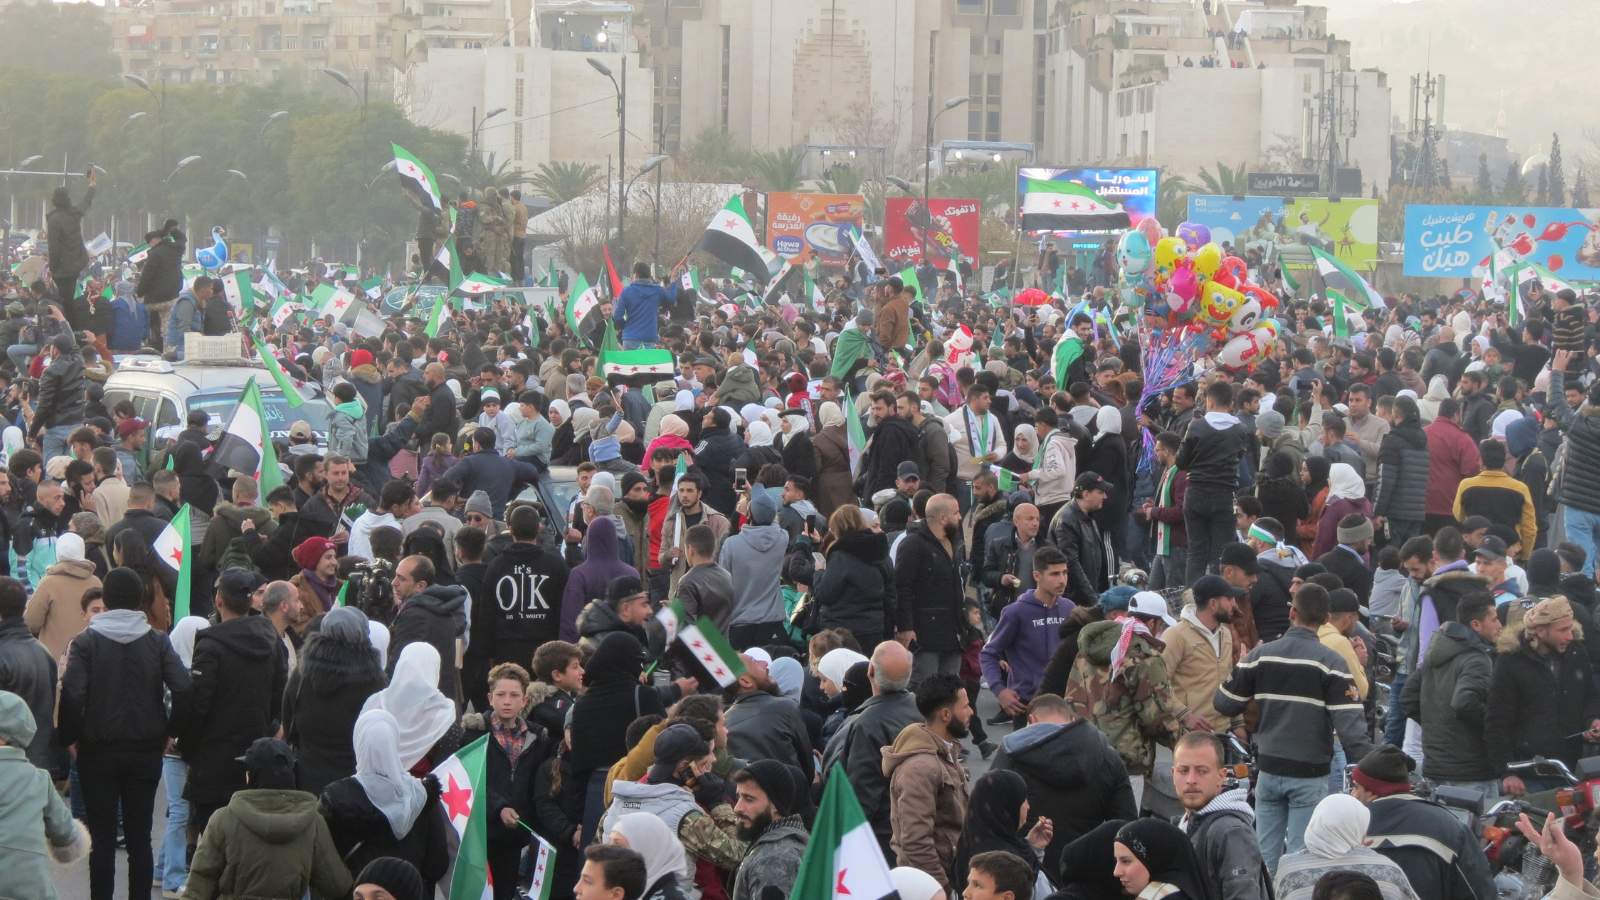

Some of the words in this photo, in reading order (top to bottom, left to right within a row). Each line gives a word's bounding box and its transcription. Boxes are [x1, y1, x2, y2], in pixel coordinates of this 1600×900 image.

[1095, 172, 1149, 184] سوريا
[1095, 185, 1149, 196] المستقبل
[968, 203, 976, 213] لا
[776, 213, 801, 224] رفيقة
[772, 221, 805, 231] المدرسة
[935, 231, 952, 247] BIG
[1420, 224, 1473, 251] طيب
[776, 240, 800, 248] Hawa
[1422, 247, 1470, 272] هيك
[514, 564, 531, 574] it's
[1032, 618, 1045, 627] THE
